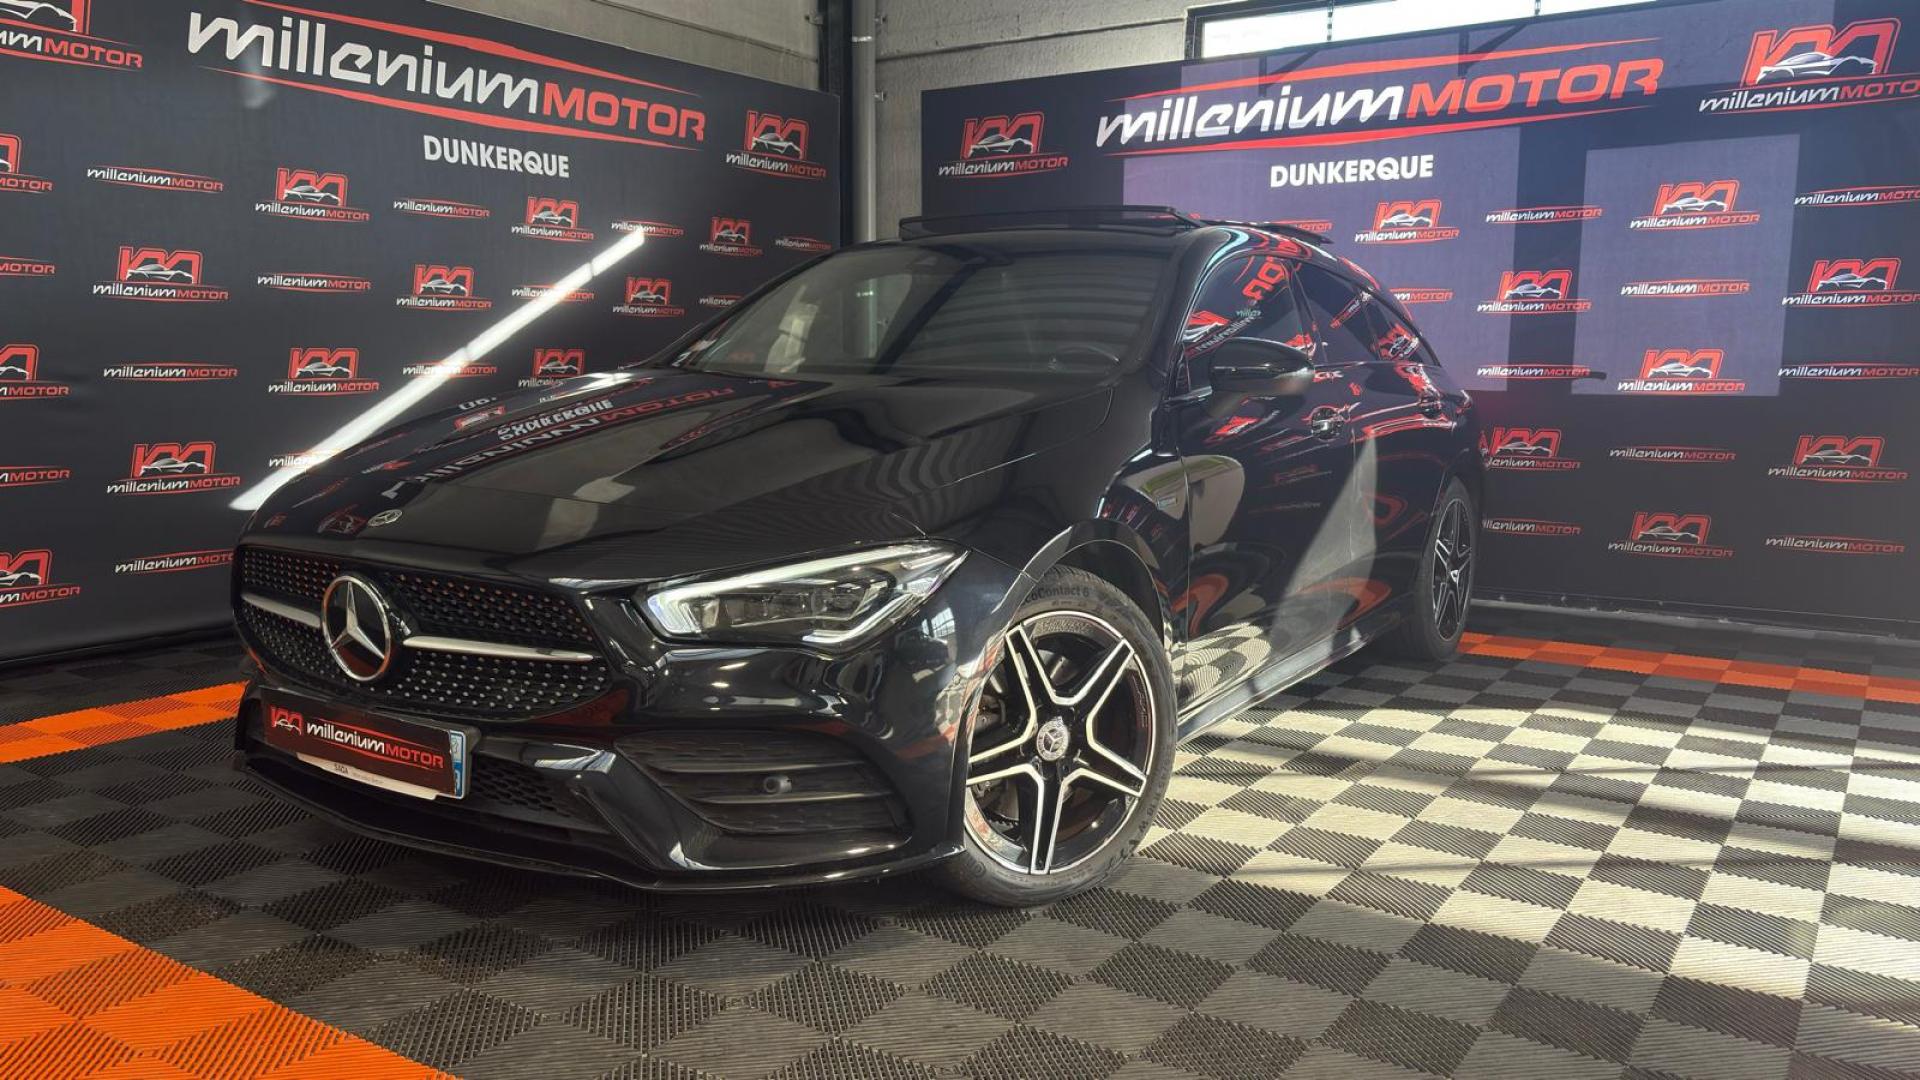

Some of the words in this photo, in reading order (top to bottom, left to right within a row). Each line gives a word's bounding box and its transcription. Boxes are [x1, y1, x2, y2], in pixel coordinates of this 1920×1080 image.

[423, 135, 570, 178] DUNKERQUE
[1270, 154, 1434, 188] DUNKERQUE
[1022, 586, 1081, 605] coContact
